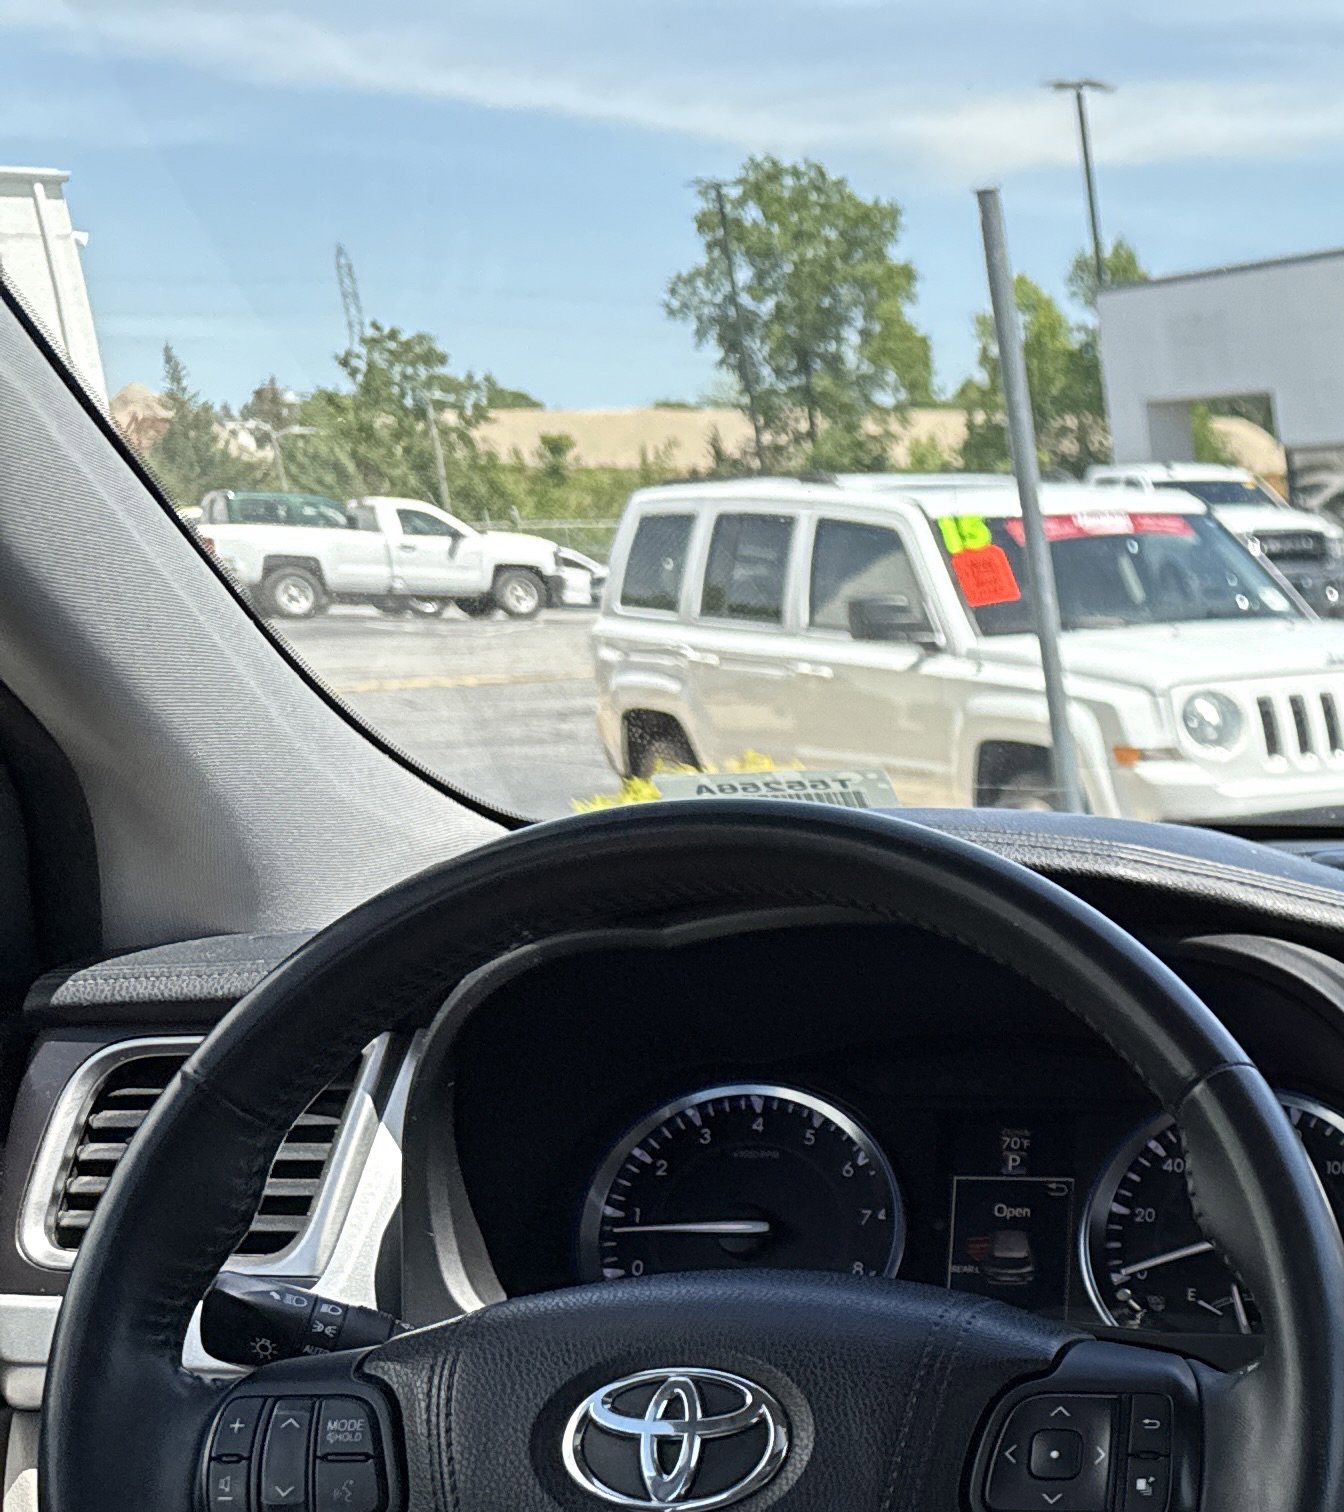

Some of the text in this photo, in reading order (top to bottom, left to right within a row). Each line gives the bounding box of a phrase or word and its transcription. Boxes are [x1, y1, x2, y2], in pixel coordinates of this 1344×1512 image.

[752, 1117, 764, 1132] 4
[700, 1129, 712, 1144] 3
[804, 1130, 816, 1145] 5
[656, 1160, 668, 1176] 2
[842, 1163, 854, 1177] 6
[1008, 1155, 1021, 1171] P
[1162, 1158, 1185, 1173] 40
[633, 1208, 641, 1223] 1
[861, 1210, 873, 1225] 7
[994, 1203, 1031, 1219] Open
[1134, 1208, 1156, 1222] 20
[631, 1260, 643, 1276] 0
[1187, 1288, 1197, 1302] E
[327, 1420, 365, 1431] MODE
